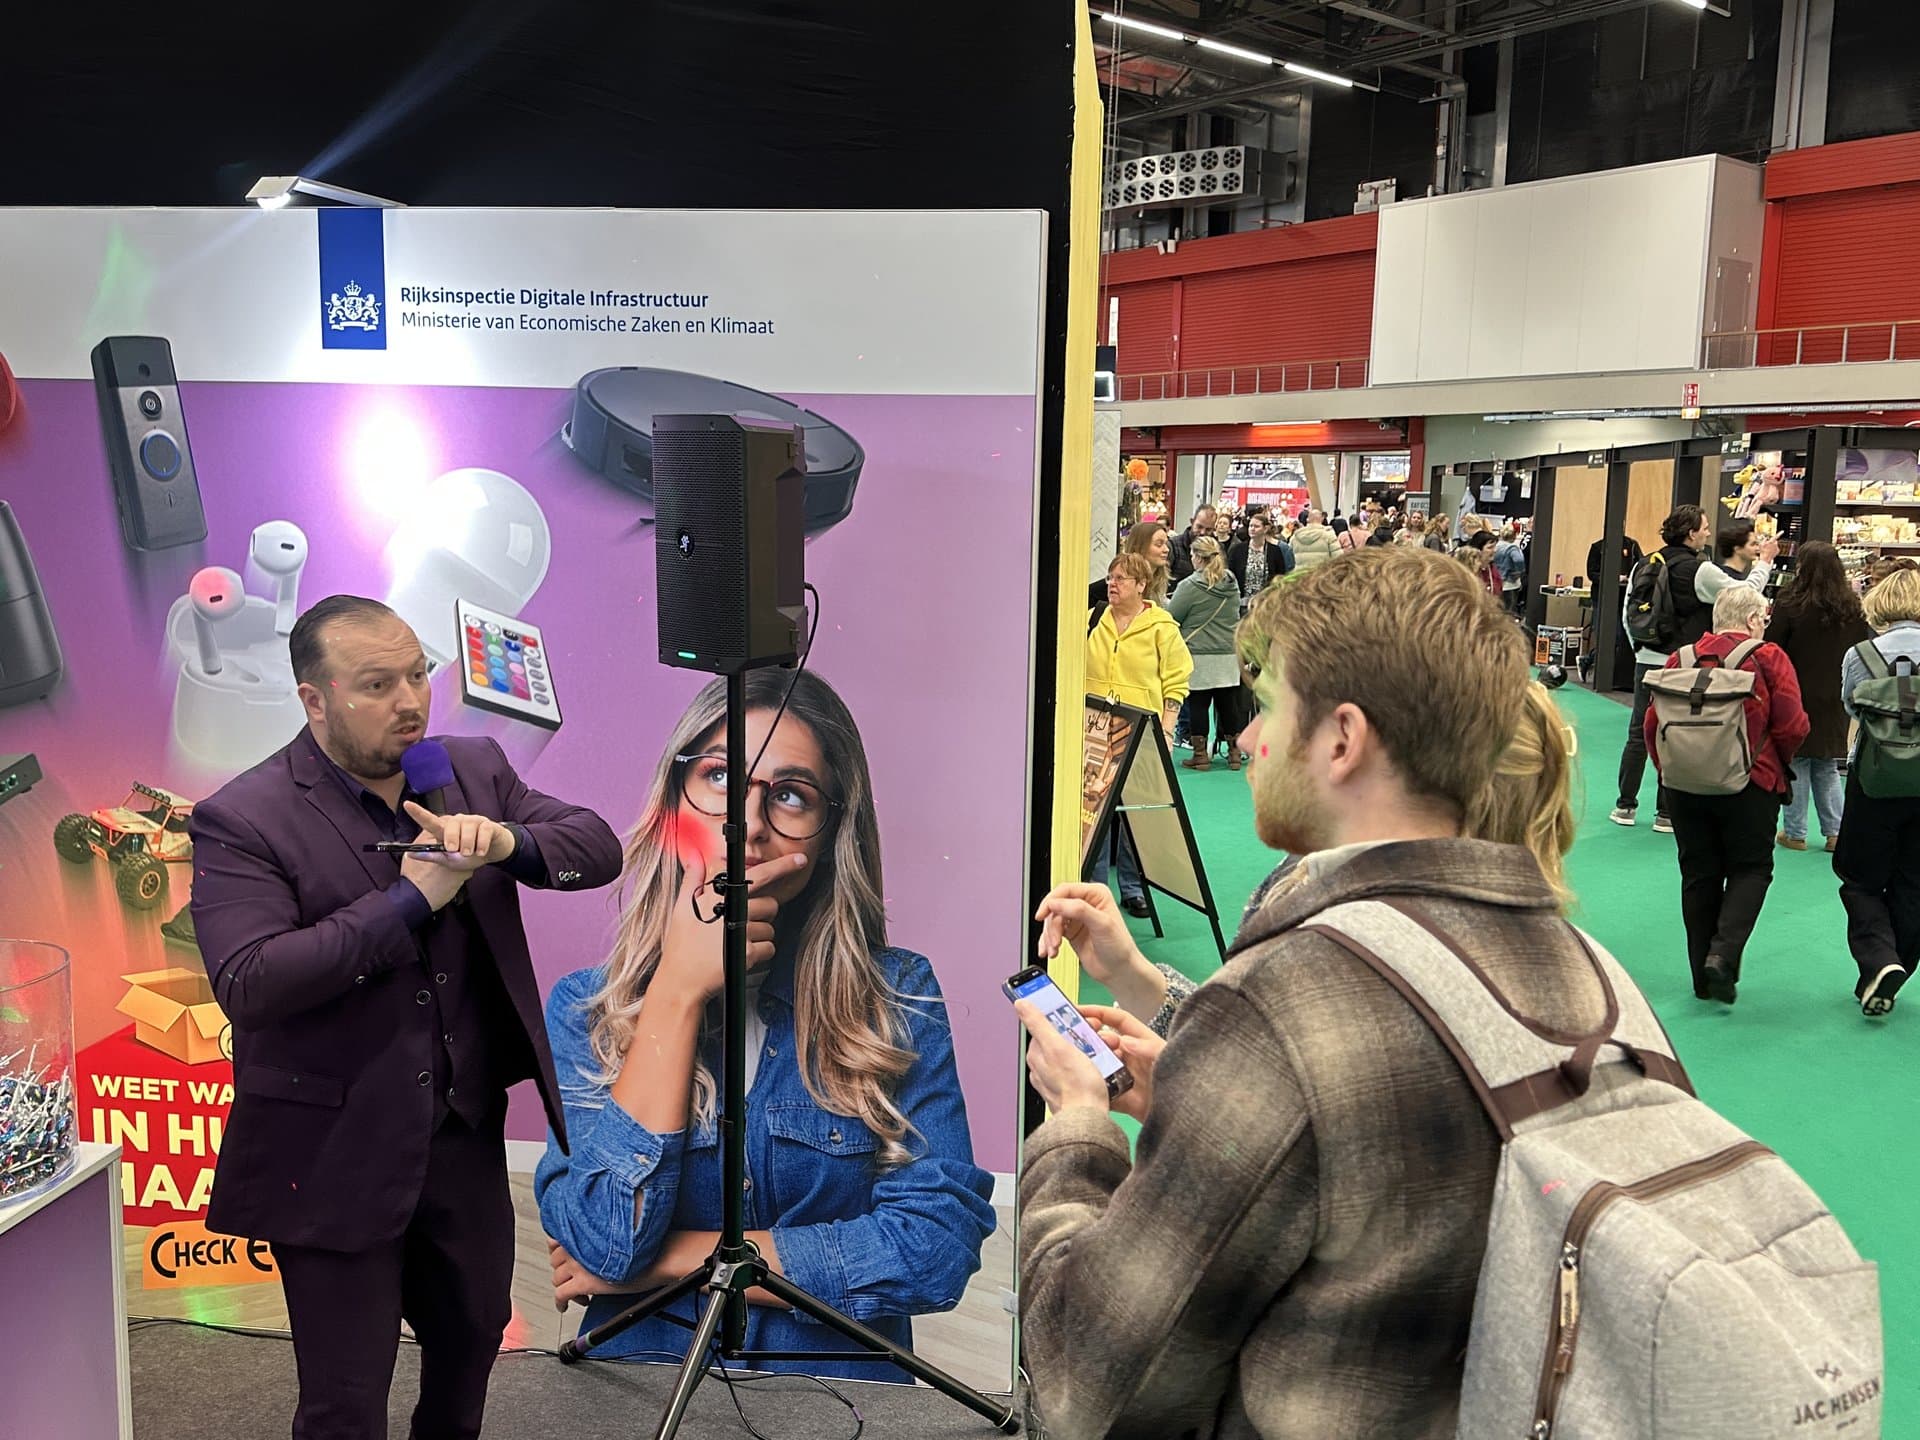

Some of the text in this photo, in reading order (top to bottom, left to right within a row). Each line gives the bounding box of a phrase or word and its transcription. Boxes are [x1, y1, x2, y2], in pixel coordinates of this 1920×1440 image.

[400, 287, 709, 309] Rijksinspectie Digitale Infrastructuur
[402, 312, 775, 334] Ministerie van Economische Zaken en Klimaat
[91, 1074, 179, 1102] WEET
[92, 1108, 149, 1152] IN
[1793, 1377, 1880, 1425] JAC HENSEN
